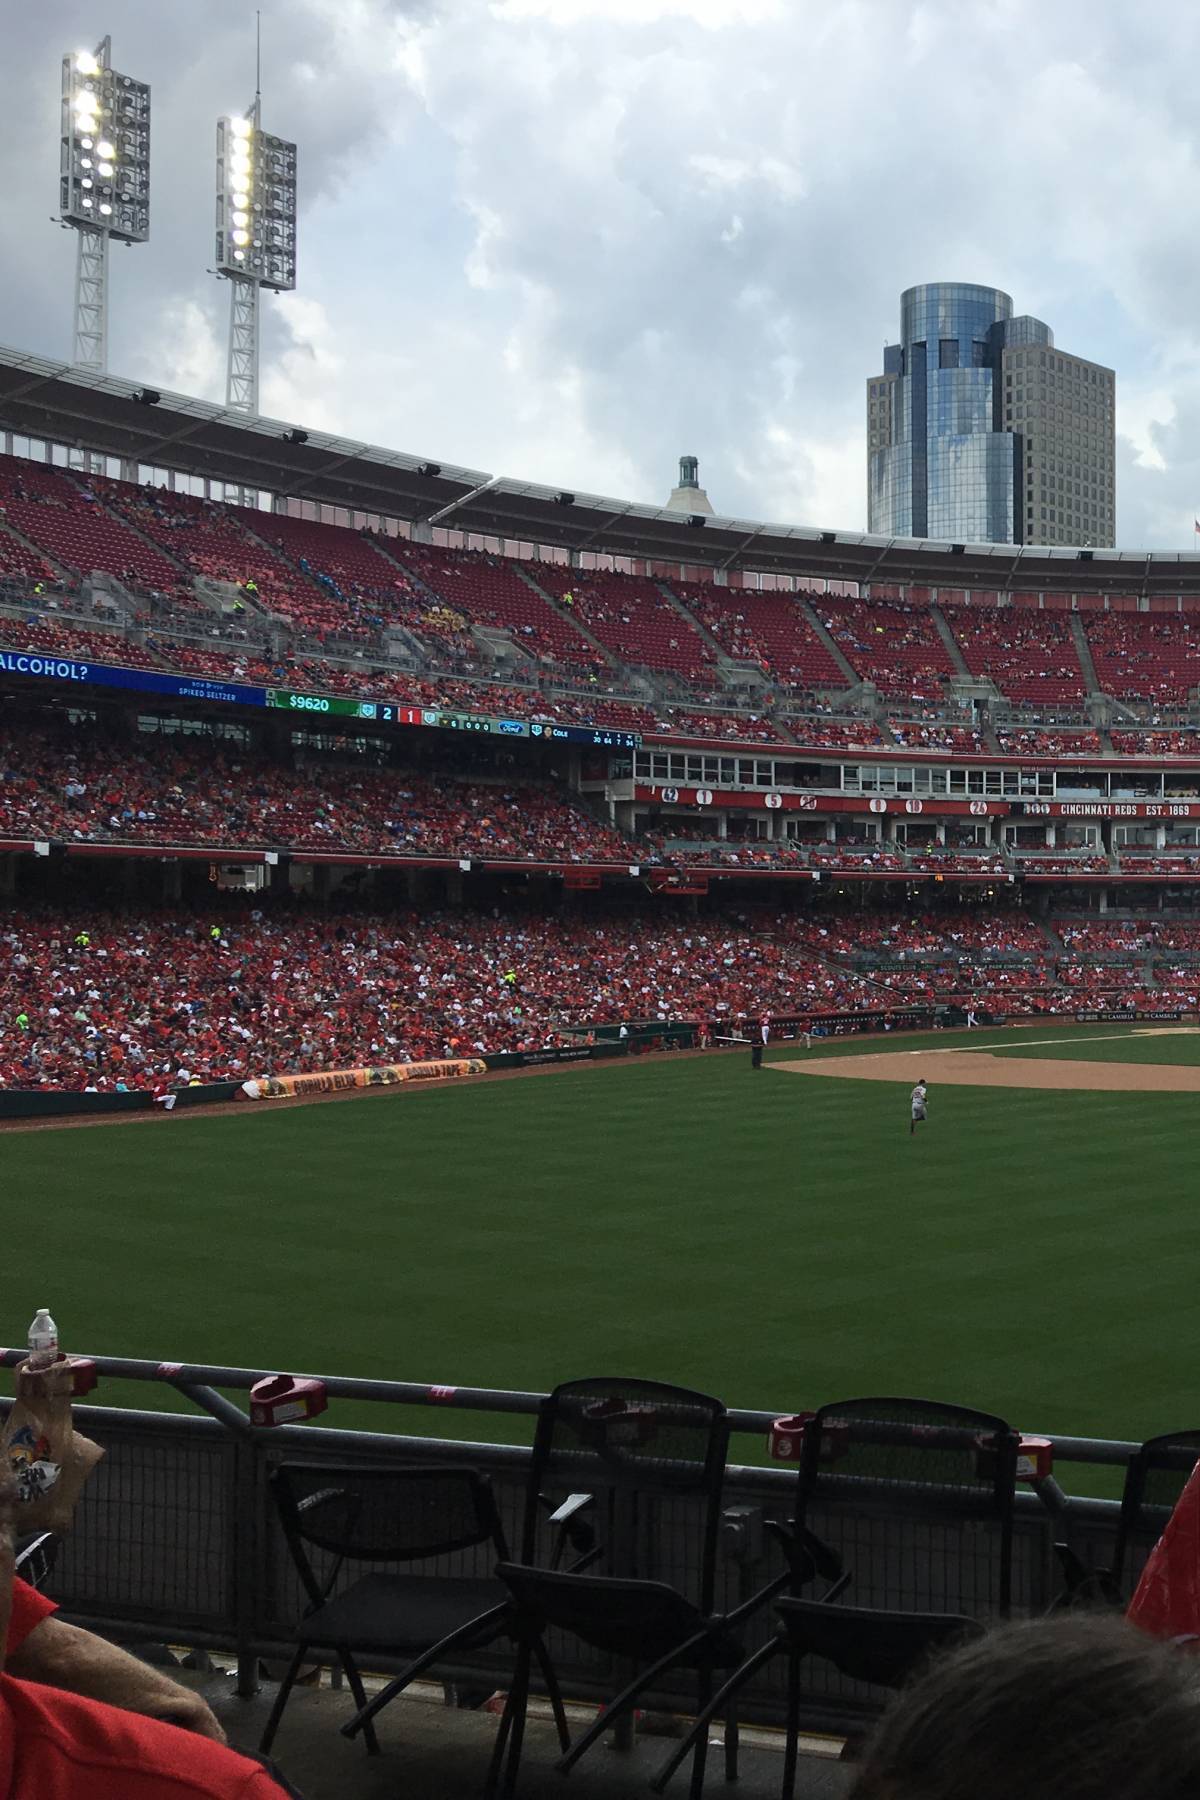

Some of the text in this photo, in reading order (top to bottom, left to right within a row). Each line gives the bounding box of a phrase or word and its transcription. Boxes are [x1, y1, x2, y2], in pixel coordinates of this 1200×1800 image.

[289, 695, 329, 712] $9620
[382, 707, 413, 723] 2 1
[771, 795, 777, 807] 5
[1061, 804, 1112, 816] CINCINNATI
[1115, 804, 1137, 816] REDS
[1146, 804, 1166, 816] EST.
[1169, 804, 1190, 816] 1869
